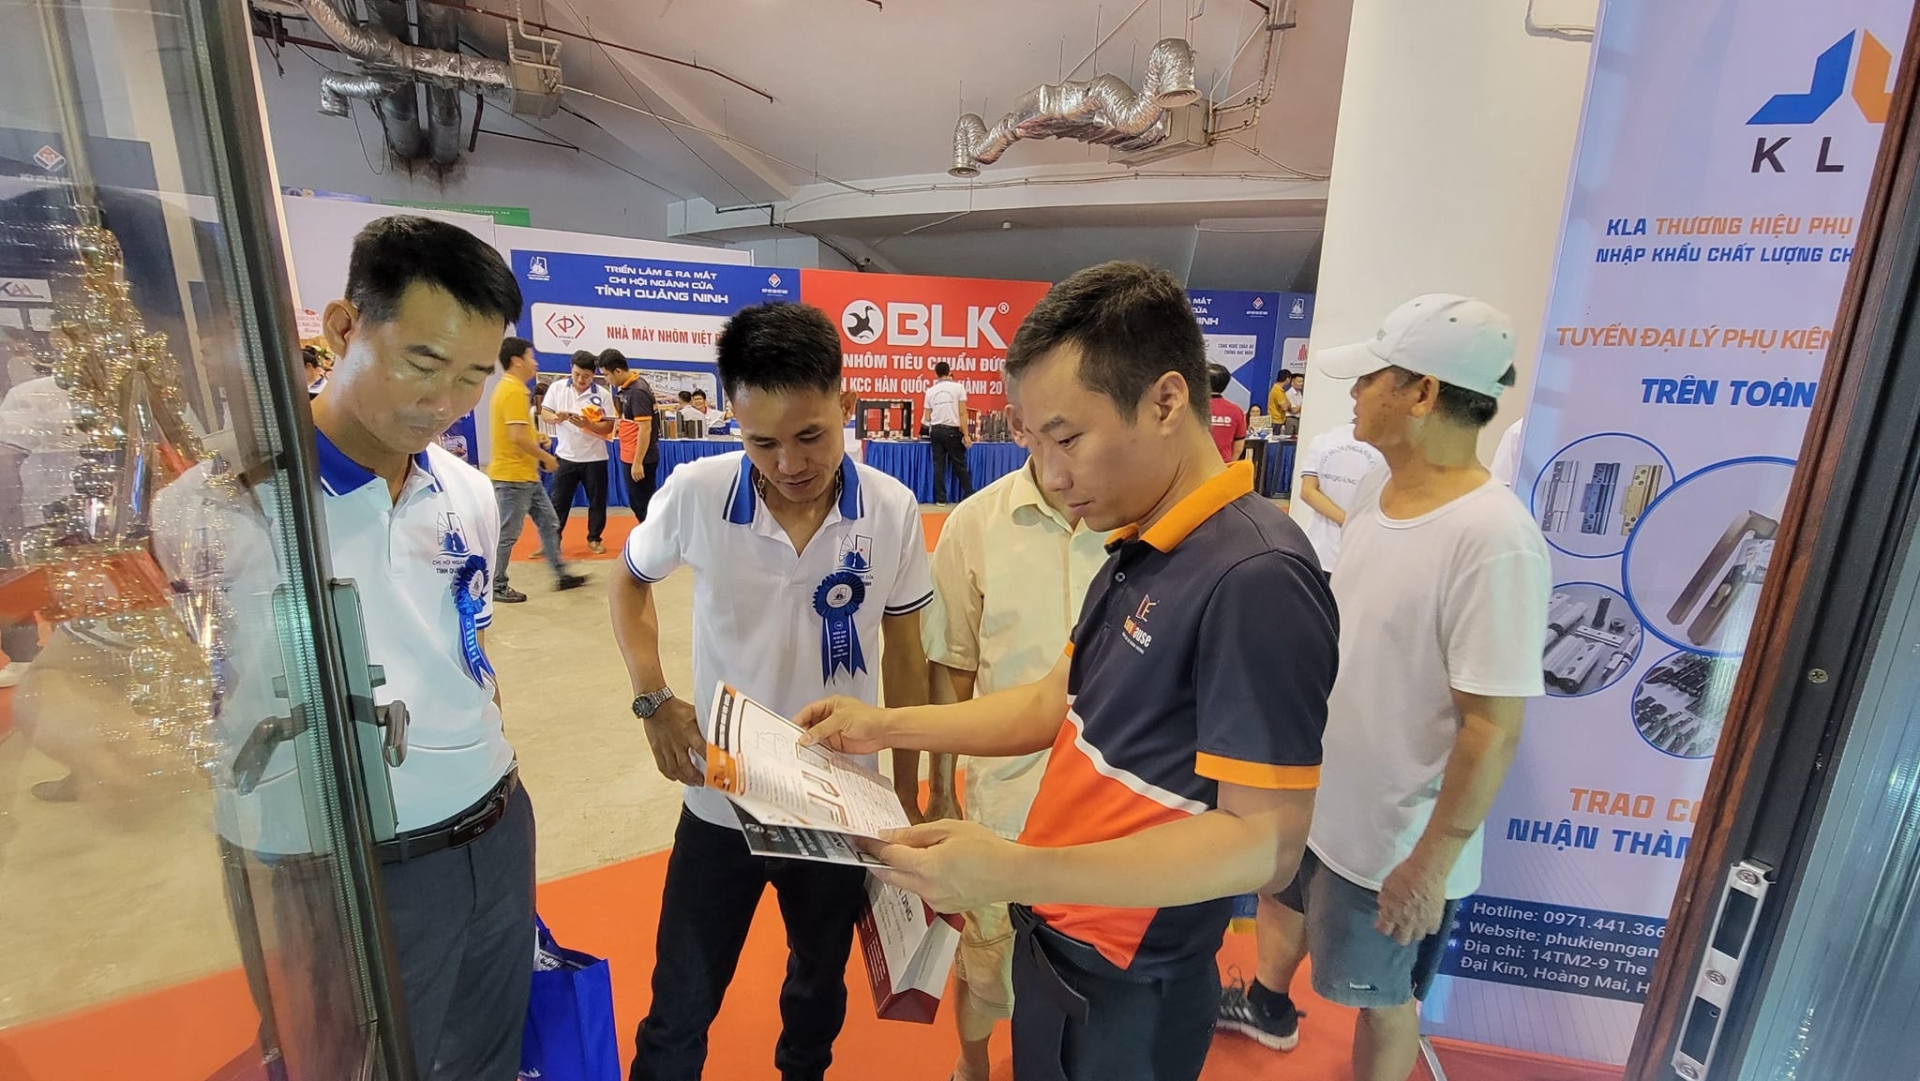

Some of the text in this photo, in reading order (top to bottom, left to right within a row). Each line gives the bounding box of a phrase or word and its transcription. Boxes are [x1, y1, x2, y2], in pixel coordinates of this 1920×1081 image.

[1606, 214, 1853, 238] KLA THƯƠNG HIỆU PHỤ
[1596, 245, 1646, 265] NHẬP
[1651, 242, 1702, 262] KHẨU
[1707, 242, 1755, 262] CHẤT
[1760, 246, 1823, 265] LƯỢNG
[595, 284, 728, 303] TỈNH QUẢNG NINH
[609, 276, 627, 284] CHI
[630, 277, 647, 286] HỘI
[650, 279, 689, 289] NGÀNH
[607, 324, 629, 340] NHÀ
[632, 325, 654, 341] MÁY
[658, 328, 688, 344] NHÔM
[691, 329, 712, 347] VIỆT
[1556, 322, 1637, 347] TUYẾN
[1640, 329, 1685, 352] ĐẠI
[1689, 324, 1717, 348] LÝ
[1722, 329, 1777, 353] PHỤ
[843, 351, 887, 369] NHÔM
[892, 353, 923, 370] TIÊU
[850, 377, 872, 392] KCC
[874, 375, 898, 393] HÀN
[901, 374, 930, 395] QUỐC
[1641, 375, 1818, 407] TRÊN TOÀN
[1570, 788, 1655, 819] TRAO
[1507, 818, 1599, 851] NHẬN
[1473, 902, 1666, 938] Hotline: 0971.441.366
[1469, 921, 1659, 958] Website: phukienngan
[1464, 939, 1648, 976] Địa chỉ: 14TM2-9 The
[1461, 956, 1651, 994] Đại Kim, Hoàng Mai, H
